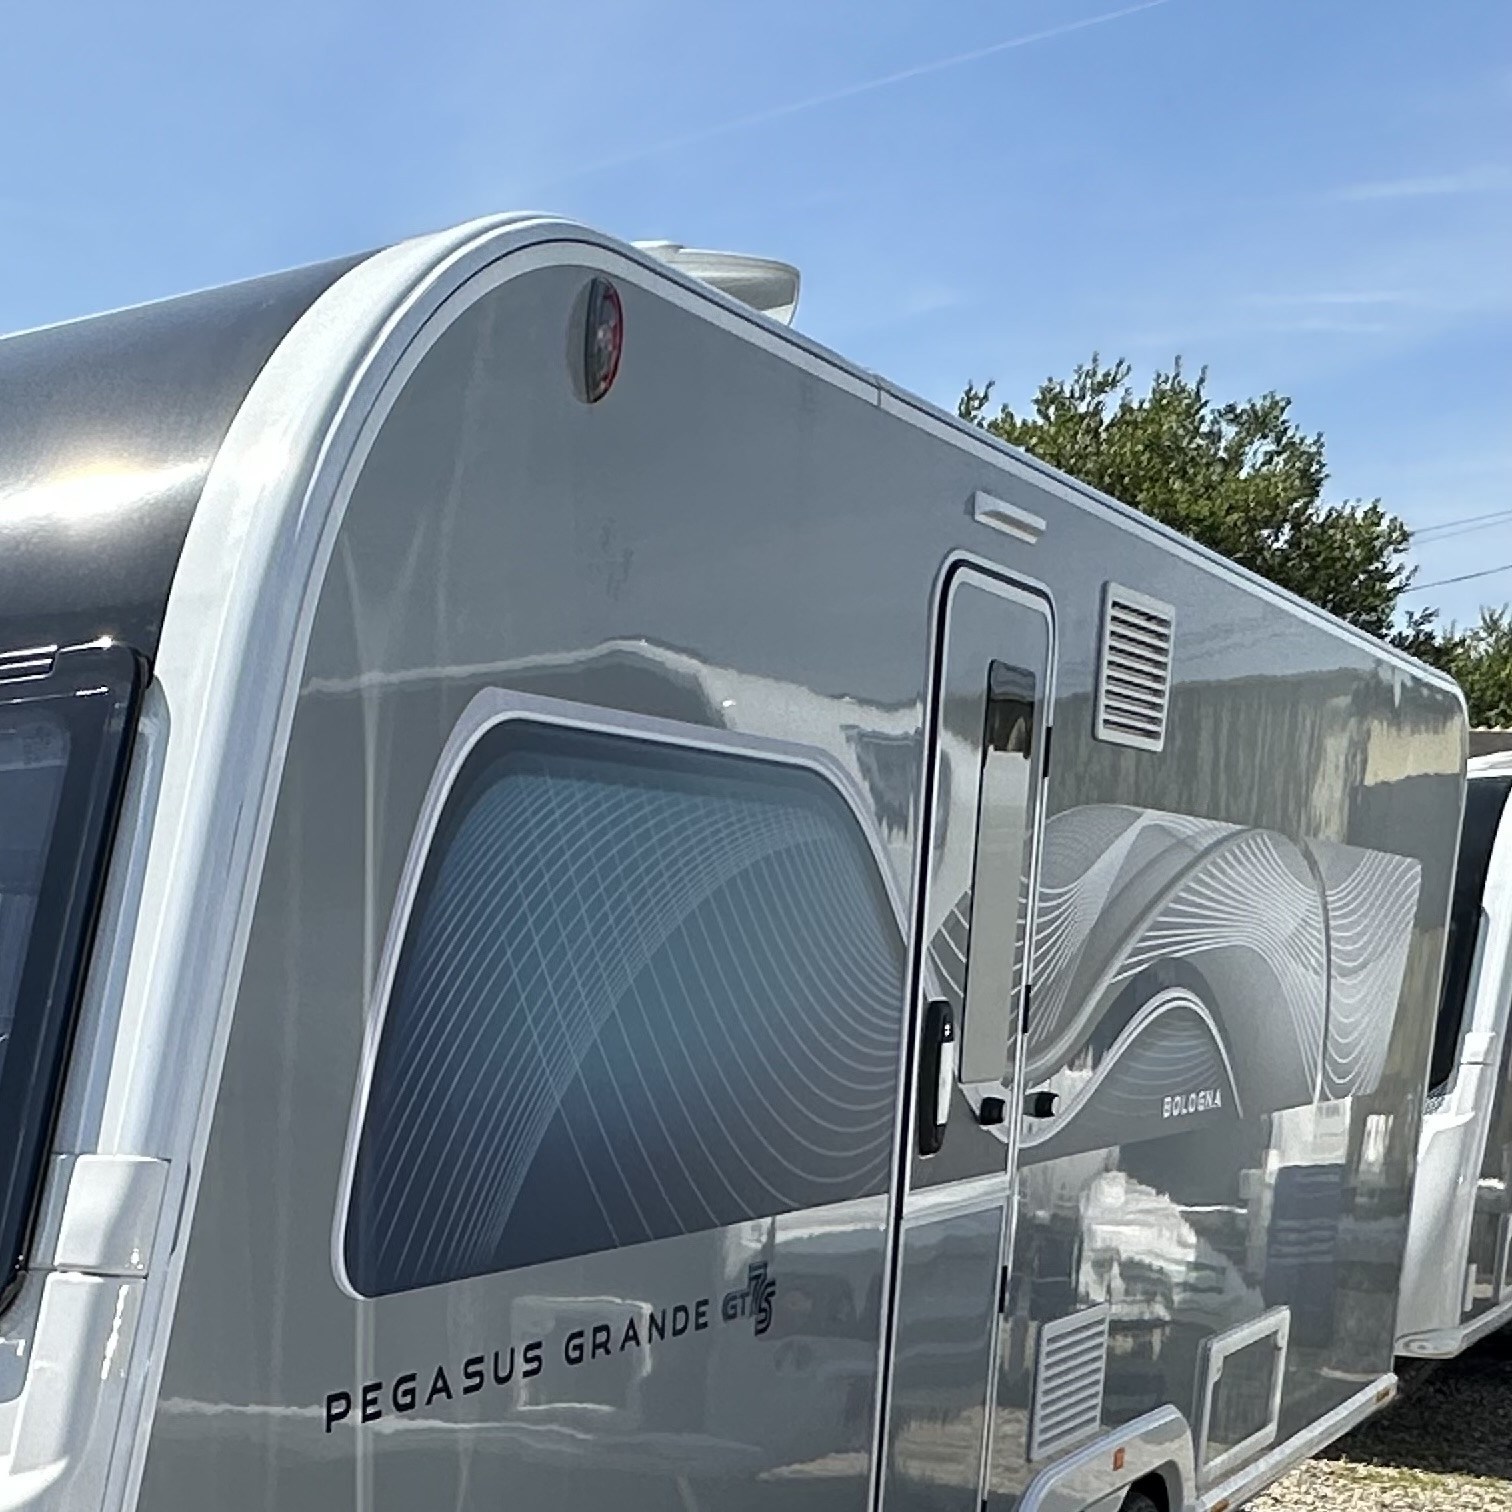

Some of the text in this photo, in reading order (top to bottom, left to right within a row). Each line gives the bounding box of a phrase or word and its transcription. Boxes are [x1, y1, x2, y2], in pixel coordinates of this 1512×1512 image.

[1162, 1088, 1222, 1118] BOLOGNA
[324, 1340, 544, 1434] PEGASUS
[563, 1299, 710, 1367] GRANDE
